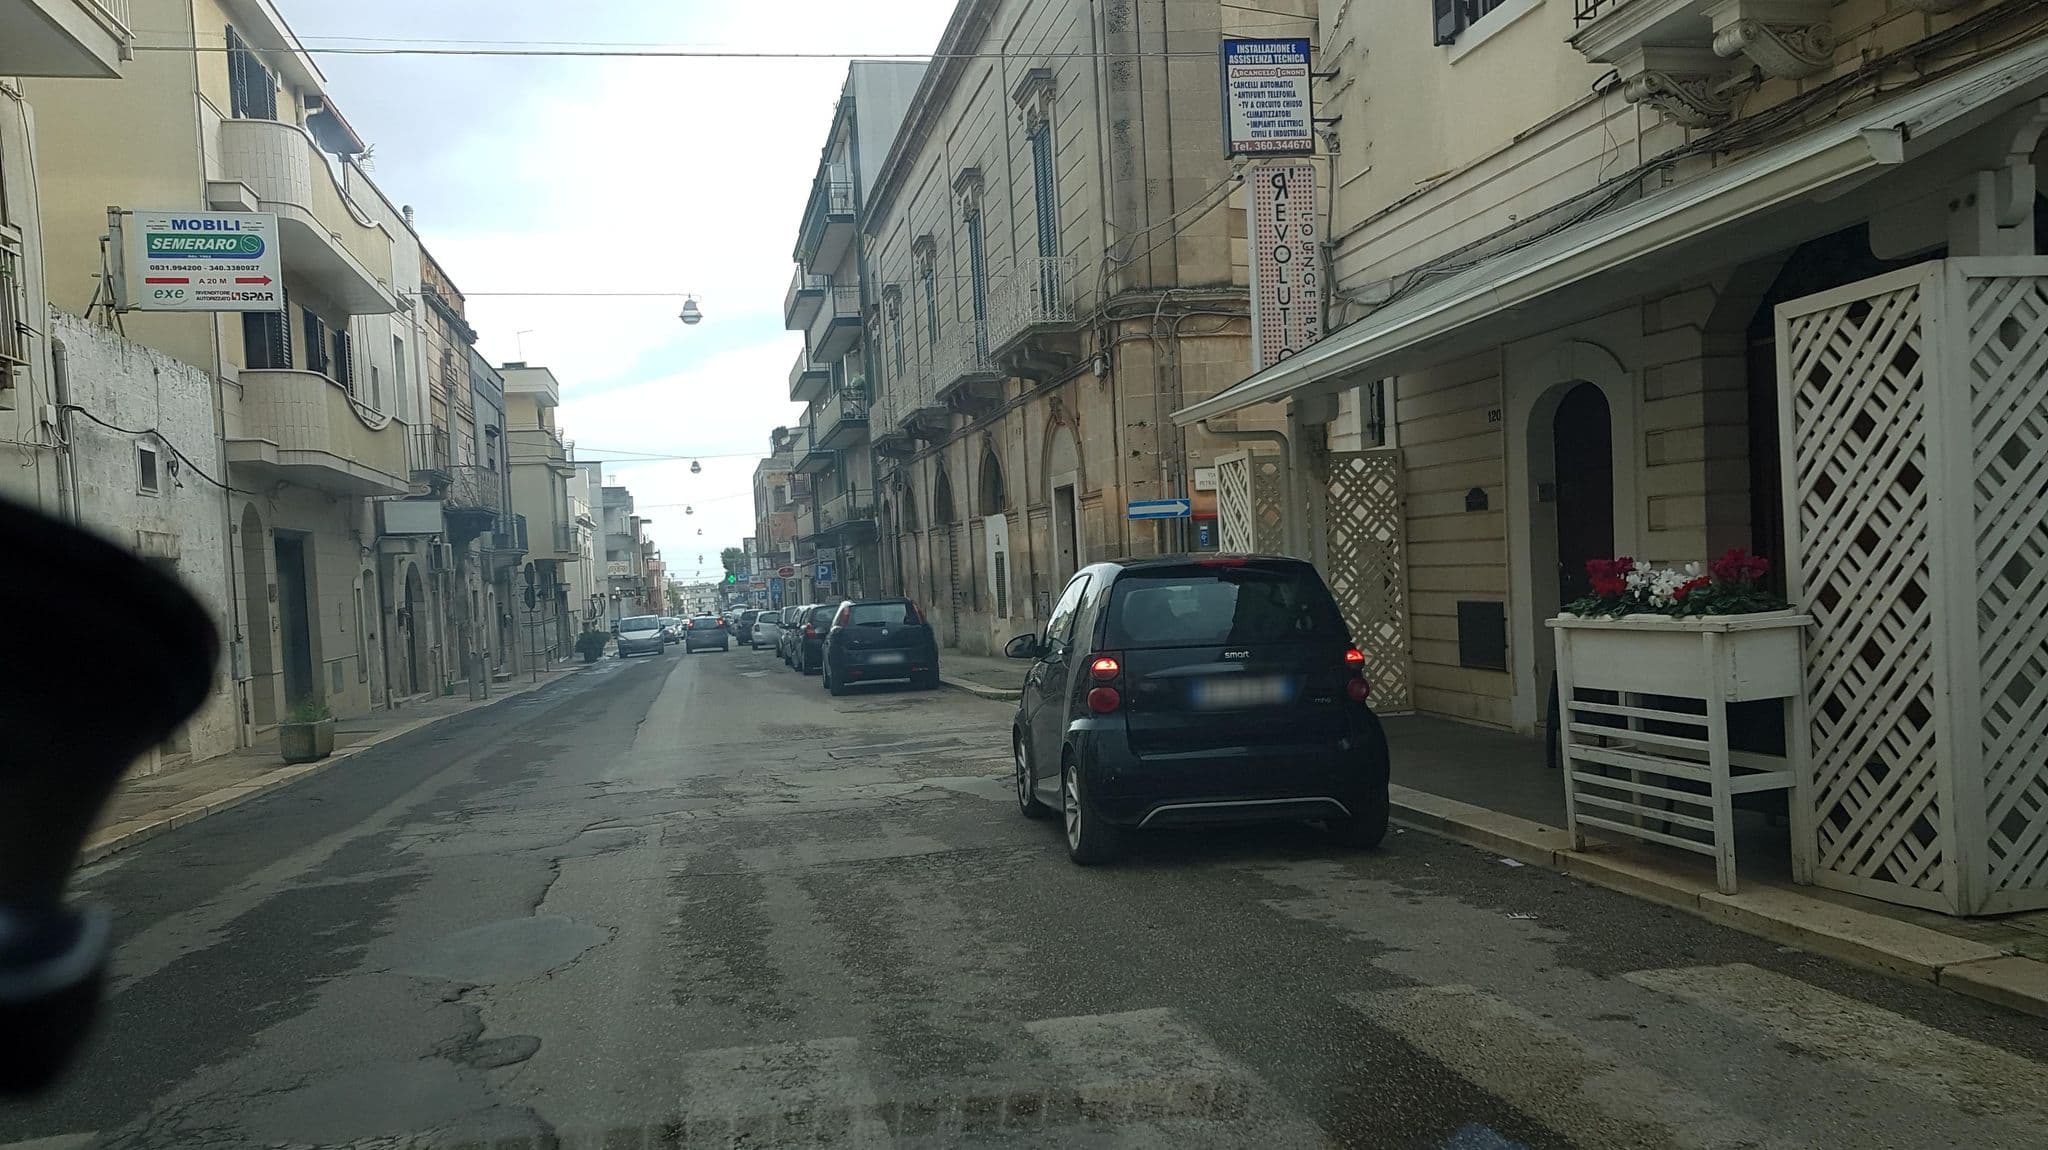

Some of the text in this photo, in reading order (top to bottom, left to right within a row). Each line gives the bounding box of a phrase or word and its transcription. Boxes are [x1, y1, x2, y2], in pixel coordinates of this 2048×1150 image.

[1237, 44, 1297, 54] INSTALLAZIONE E
[1229, 53, 1305, 64] ASSISTENZA TECNICA
[1233, 80, 1294, 89] CANCELLI AUTOMATICI
[1238, 90, 1297, 99] ANTIFURTI TELEFONIA
[1242, 101, 1249, 109] TV
[1255, 100, 1282, 108] CIRCUITO
[1283, 99, 1303, 108] CHIUSO
[1246, 110, 1292, 119] CLIMATIZZATORI
[1250, 119, 1304, 128] IMPIANTI ELETTRICI
[1251, 129, 1308, 138] CIVILI E INDUSTRIALI
[1233, 140, 1312, 152] Tel. 360.344670
[171, 219, 241, 232] MOBILI
[151, 237, 238, 251] SEMERARO
[1301, 212, 1316, 298] LOUNGE
[153, 289, 185, 300] exe
[241, 291, 274, 302] SPAR
[1488, 408, 1502, 423] 120
[818, 565, 829, 579] P
[1224, 650, 1250, 659] smart
